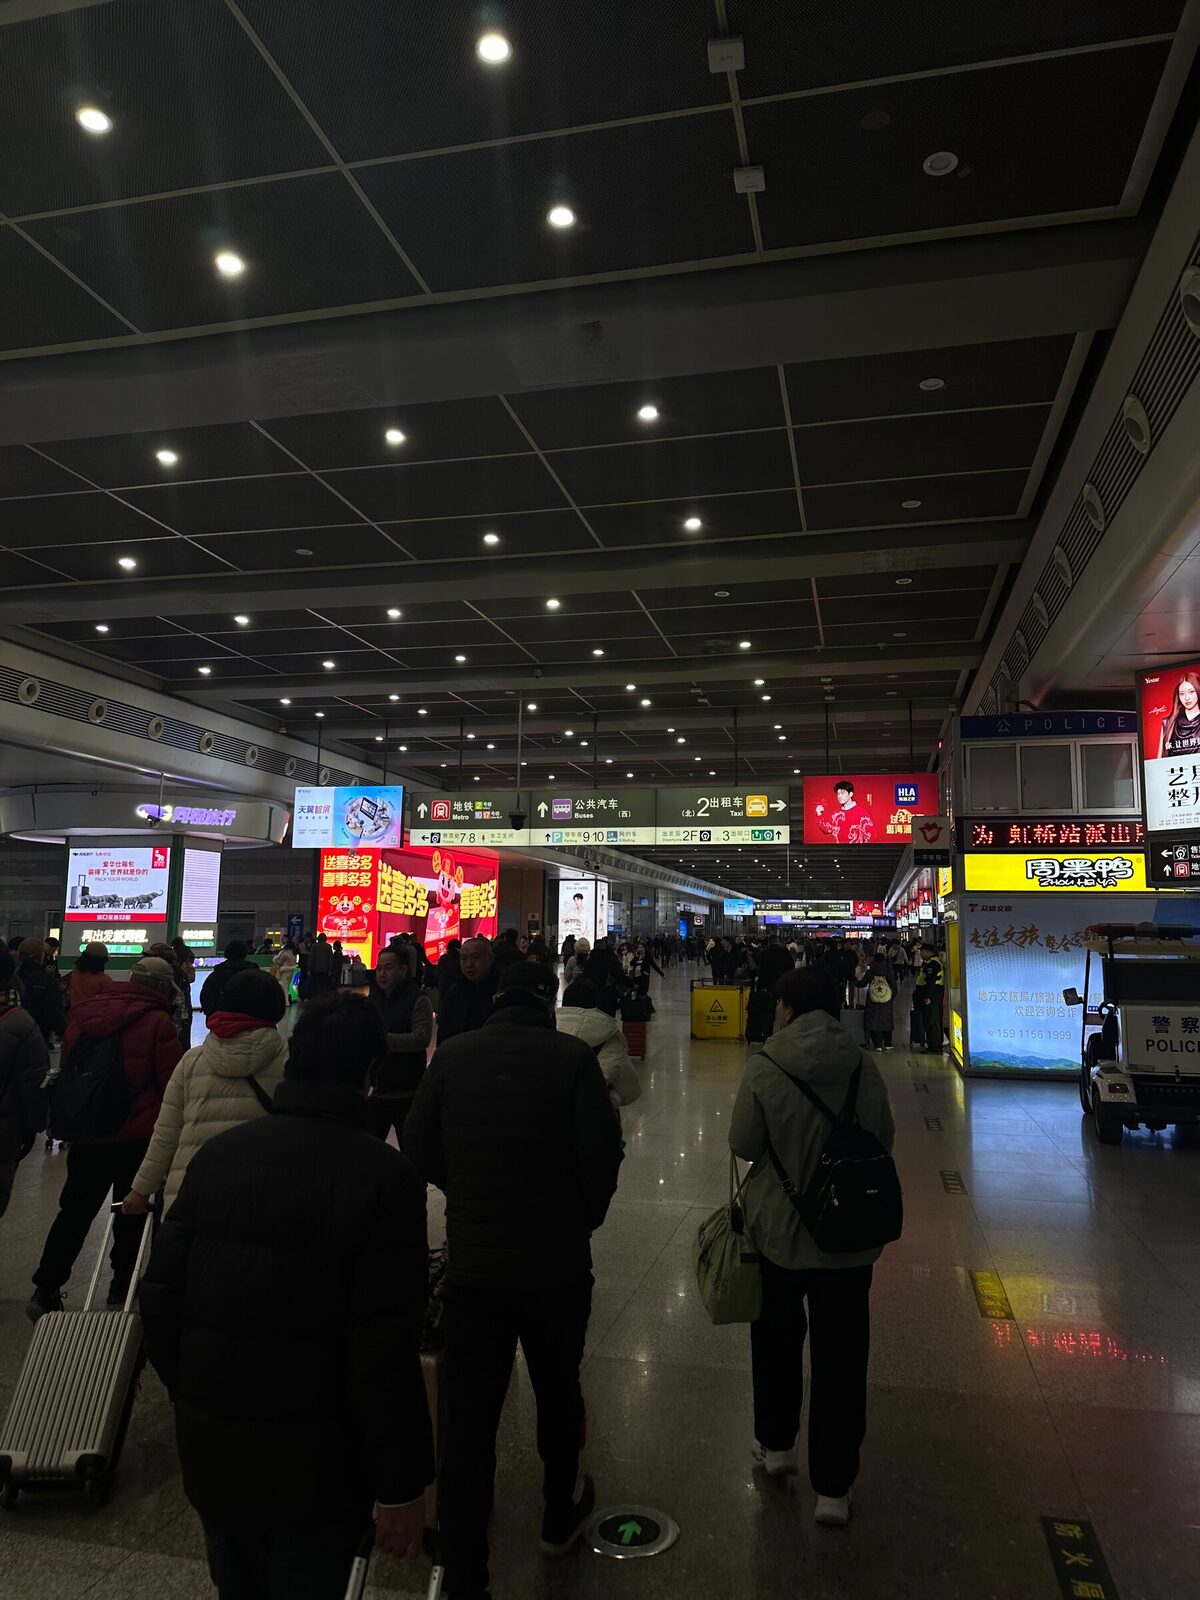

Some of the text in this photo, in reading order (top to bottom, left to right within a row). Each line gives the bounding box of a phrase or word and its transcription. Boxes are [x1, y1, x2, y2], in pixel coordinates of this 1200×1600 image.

[1024, 716, 1128, 731] POLICE
[898, 787, 915, 797] HLA
[453, 801, 473, 811] 地铁
[575, 799, 618, 810] 公共汽车
[697, 798, 710, 817] 2
[710, 797, 743, 808] 出租车
[683, 830, 698, 841] 2F
[723, 830, 730, 841] 3
[973, 825, 993, 846] 为
[324, 855, 373, 871] 送喜多多
[1026, 857, 1134, 879] 周黑鸭
[323, 872, 372, 888] 喜事多多
[376, 859, 429, 918] 送喜多多
[1014, 1005, 1077, 1019] 欢迎咨询合作
[1151, 1015, 1200, 1034] 警察
[998, 1029, 1072, 1040] 159 1156 1999
